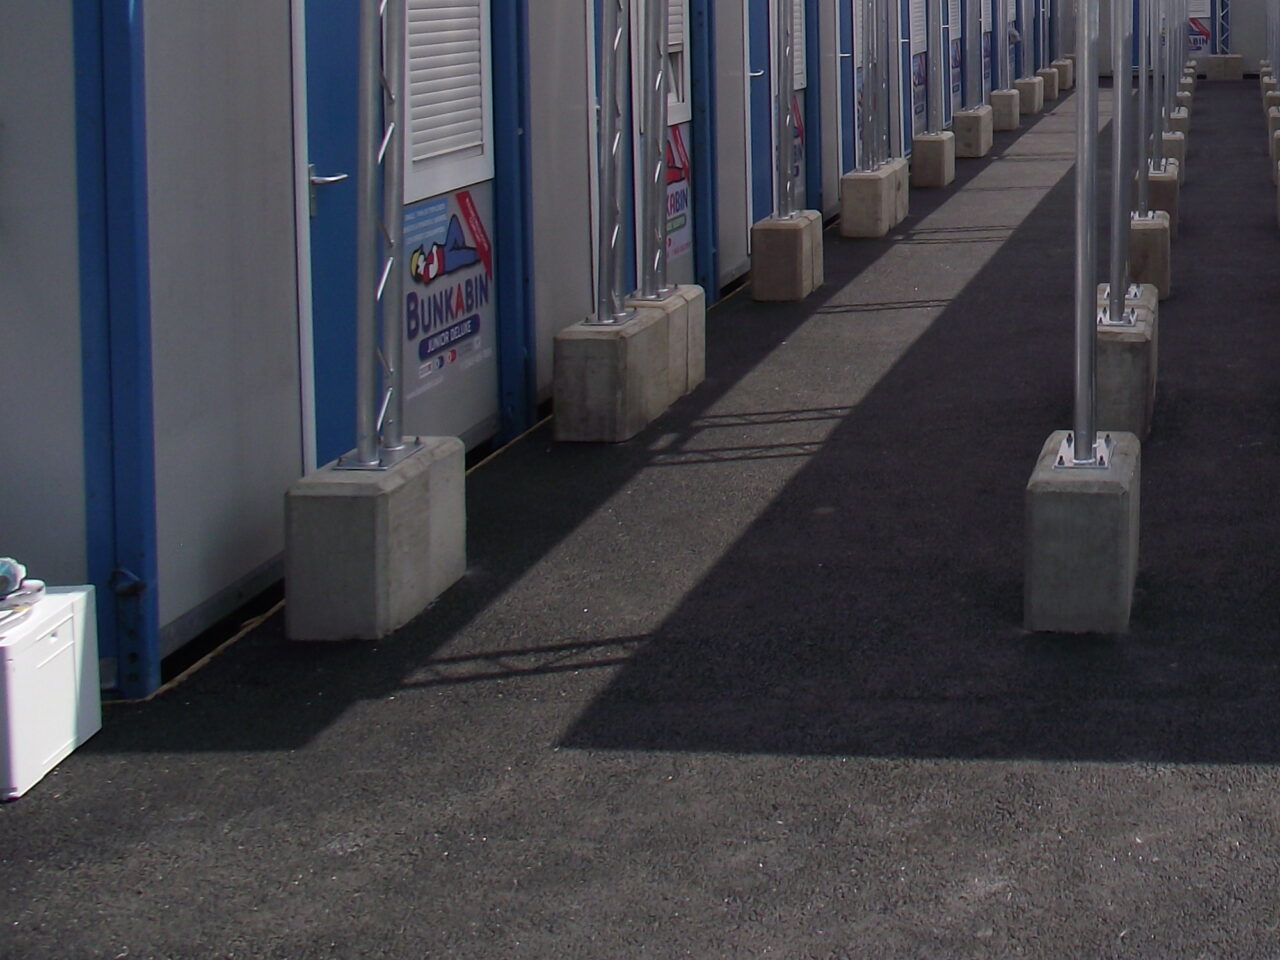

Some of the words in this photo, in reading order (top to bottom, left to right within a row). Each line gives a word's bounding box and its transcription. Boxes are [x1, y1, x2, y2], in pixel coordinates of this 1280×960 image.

[406, 271, 489, 341] BUNKABIN
[427, 330, 450, 353] JUNIOR
[449, 319, 472, 342] DELUXE
